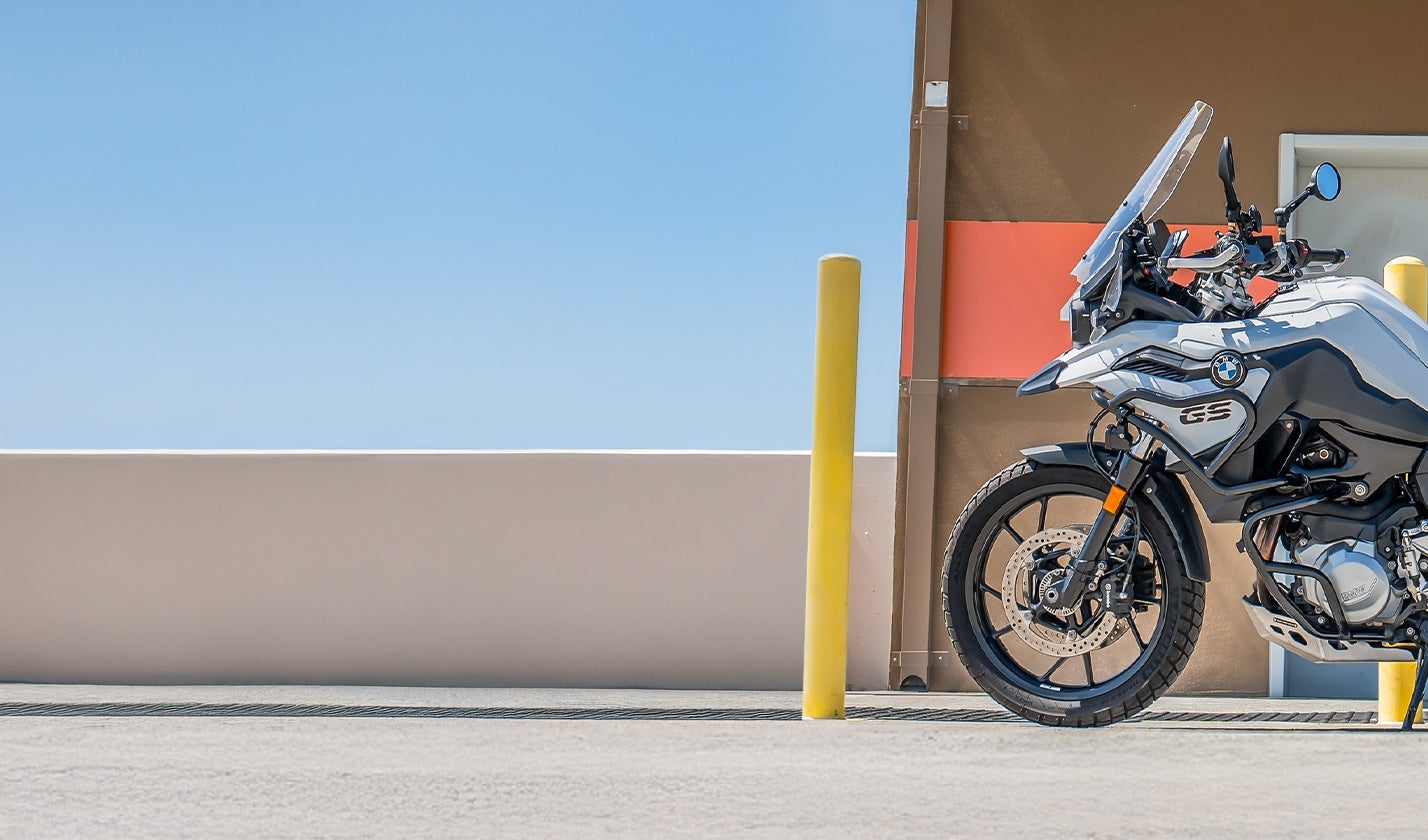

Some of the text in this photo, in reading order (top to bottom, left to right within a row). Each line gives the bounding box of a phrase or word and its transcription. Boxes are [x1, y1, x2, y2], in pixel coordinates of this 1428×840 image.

[1213, 355, 1240, 368] BMW
[1180, 401, 1232, 425] GS
[1341, 585, 1365, 601] BMW
